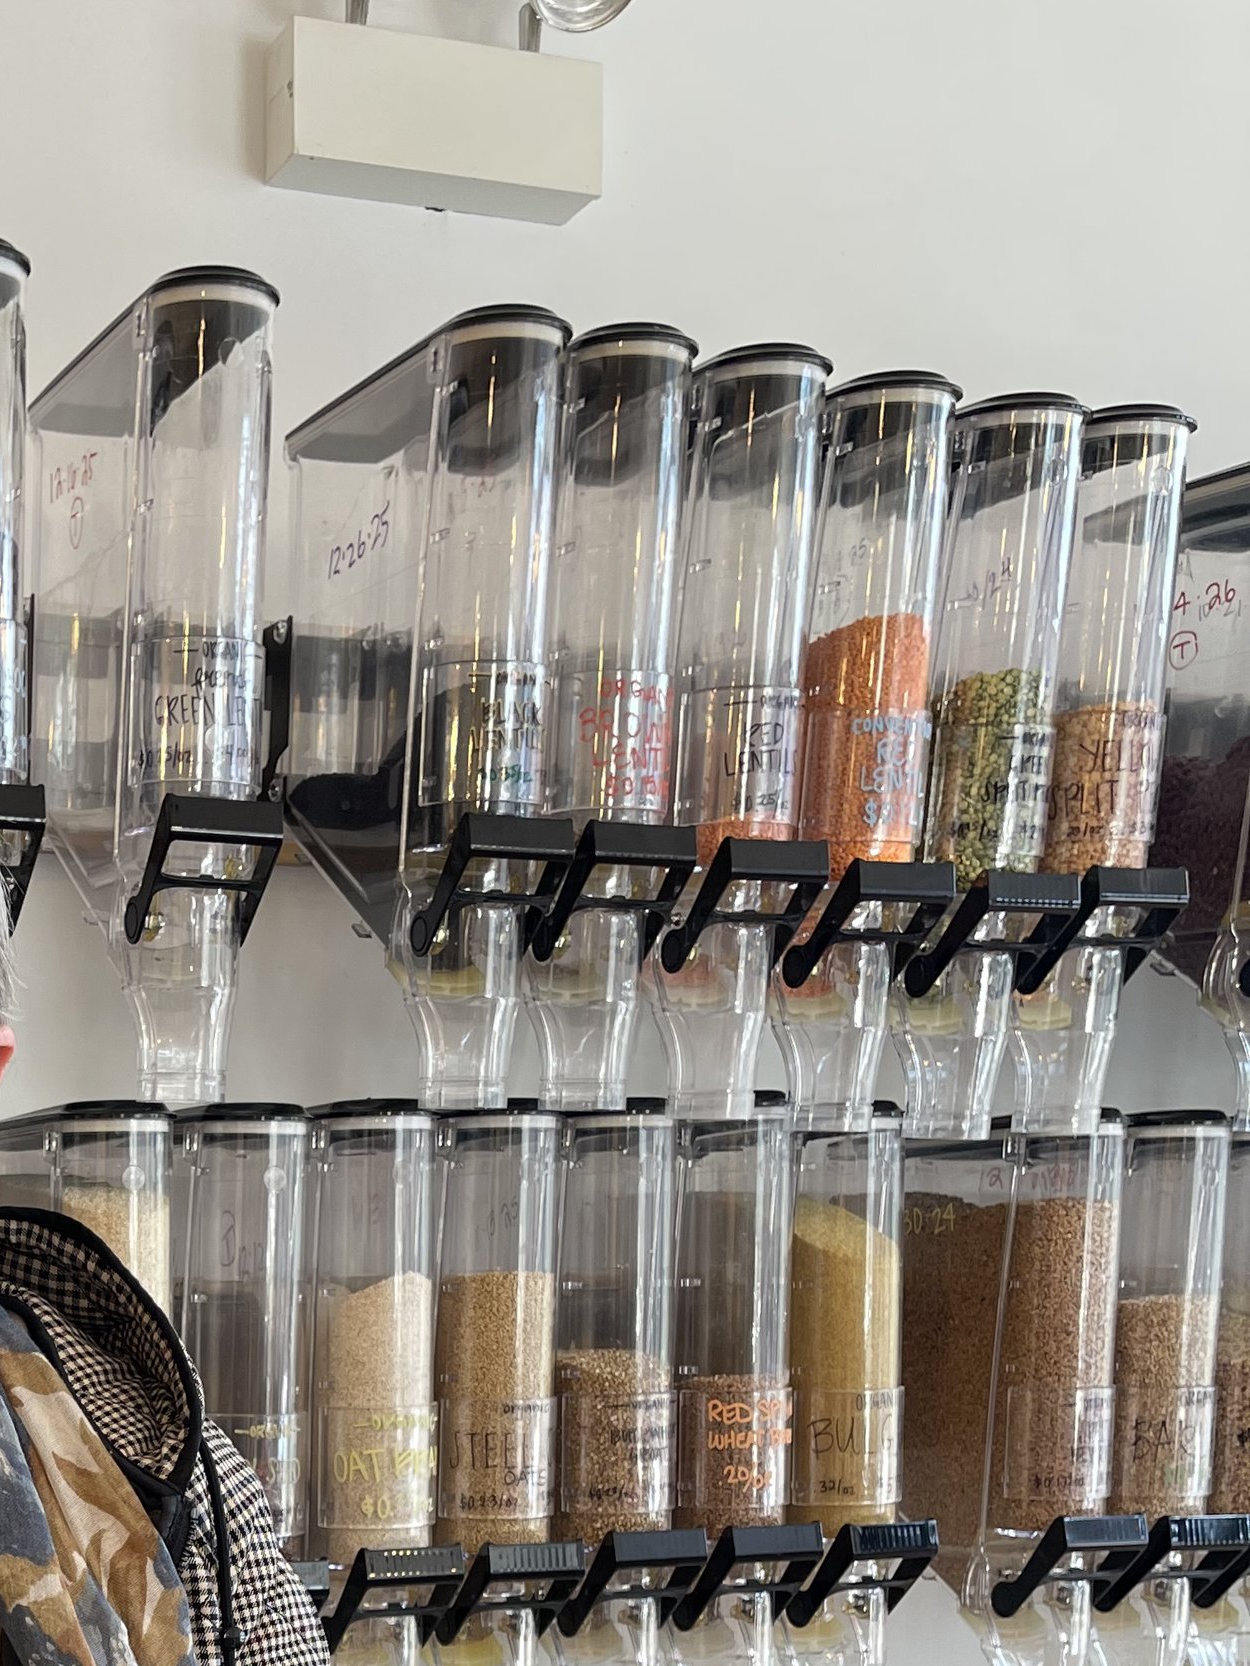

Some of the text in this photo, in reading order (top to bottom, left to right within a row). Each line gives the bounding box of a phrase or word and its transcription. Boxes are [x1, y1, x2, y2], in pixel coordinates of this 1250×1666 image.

[154, 693, 216, 727] GREEN
[744, 721, 784, 748] RED
[1045, 779, 1120, 821] SPLIT
[708, 1399, 753, 1425] RED
[450, 1428, 534, 1472] STEEL
[708, 1429, 766, 1451] WHEAT
[333, 1448, 384, 1484] OAT
